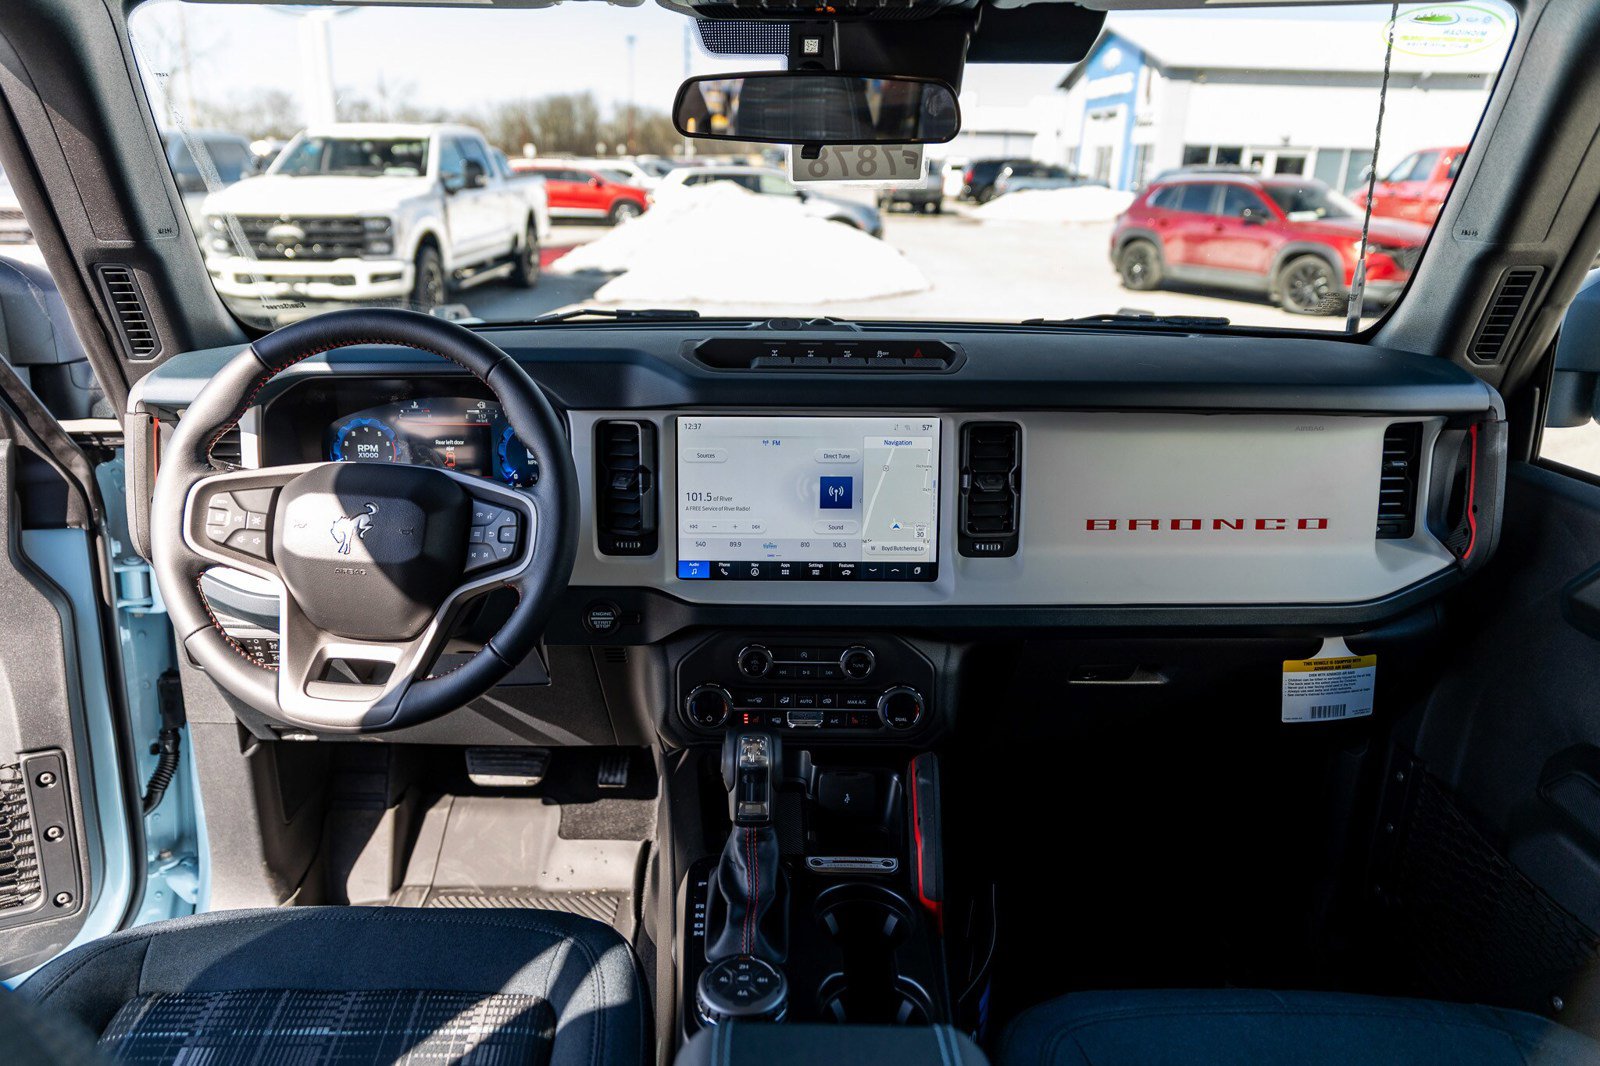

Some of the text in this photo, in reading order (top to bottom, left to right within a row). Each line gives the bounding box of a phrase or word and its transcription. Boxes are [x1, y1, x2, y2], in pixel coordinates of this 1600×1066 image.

[884, 439, 913, 447] Navigation
[357, 444, 379, 452] RPM
[686, 492, 712, 501] 101.5
[1086, 518, 1329, 531] BRONCO
